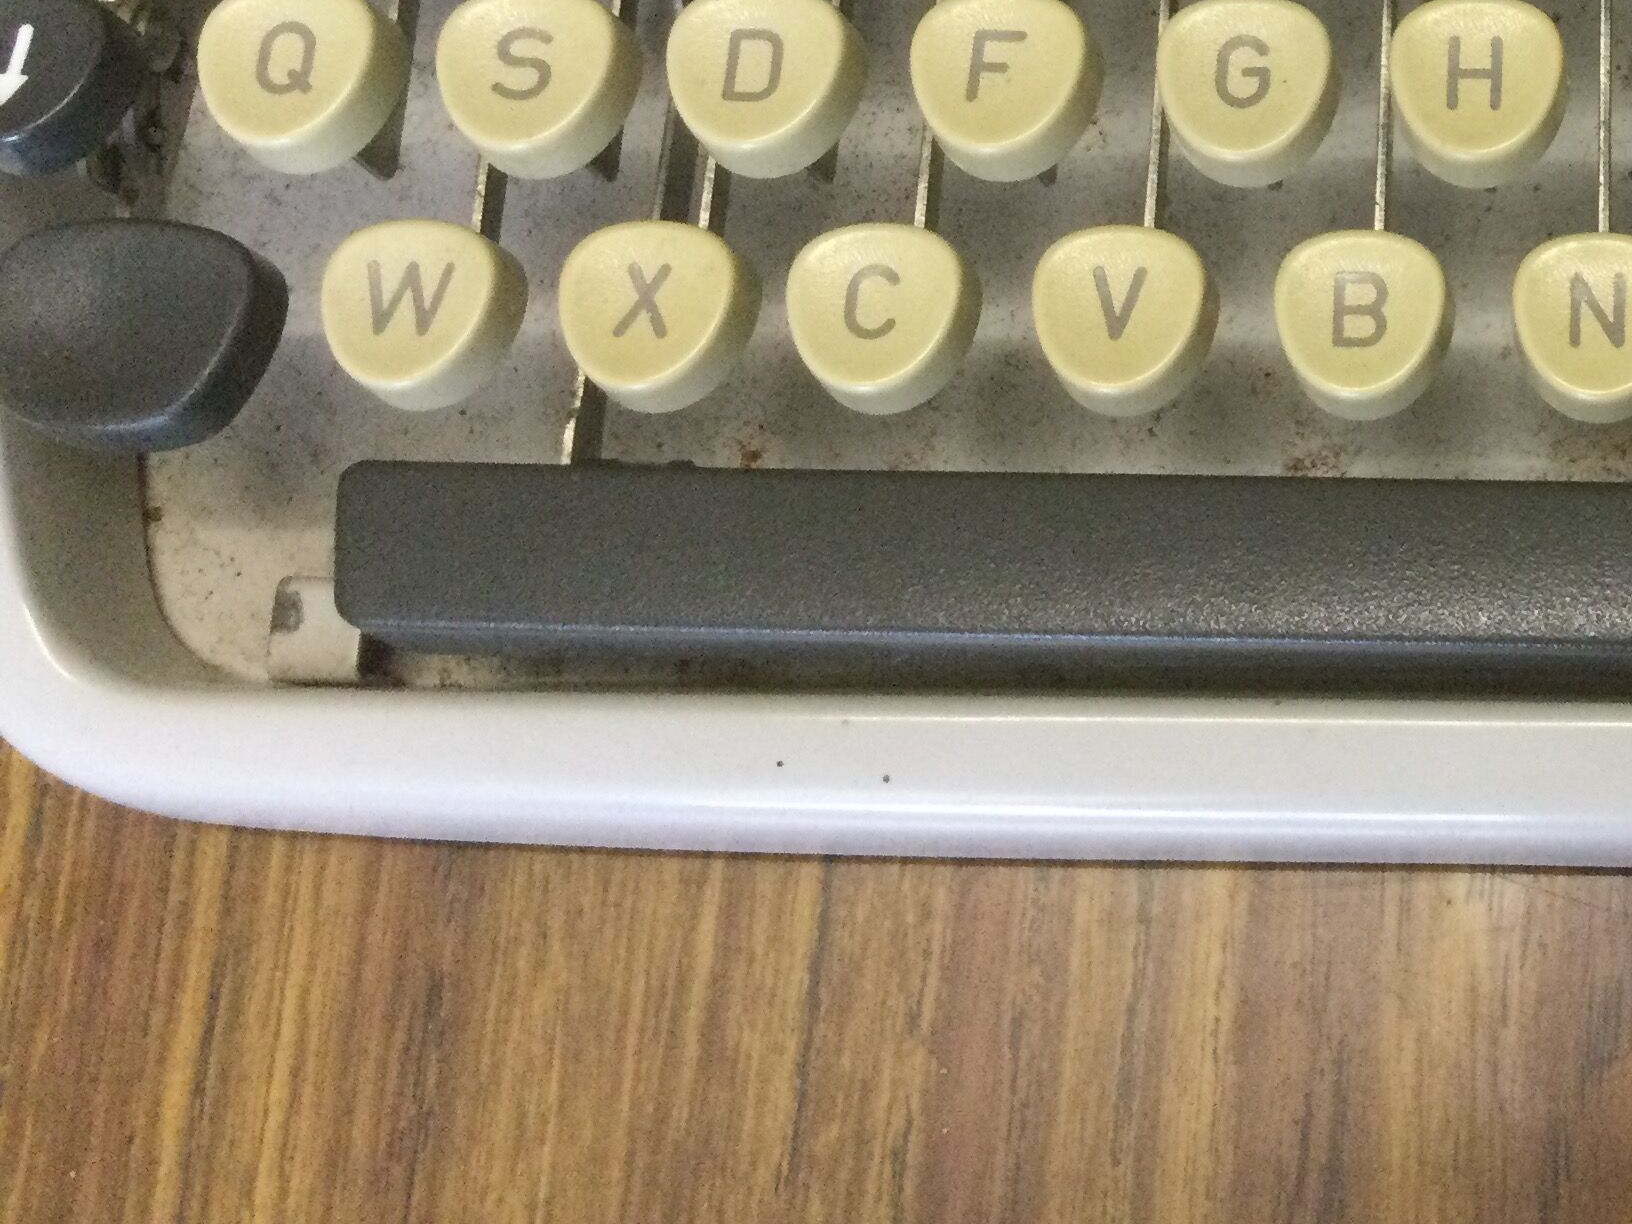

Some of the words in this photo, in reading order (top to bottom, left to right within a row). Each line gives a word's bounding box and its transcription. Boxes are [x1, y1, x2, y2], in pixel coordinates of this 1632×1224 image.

[256, 21, 316, 95] Q
[491, 28, 553, 101] S
[721, 29, 784, 102] D
[965, 29, 1027, 102] F
[1214, 35, 1271, 109] G
[1446, 36, 1503, 111] H
[368, 260, 455, 336] W
[613, 263, 672, 338] X
[844, 265, 900, 340] C
[1093, 266, 1147, 341] V
[1332, 272, 1388, 348] B
[1569, 272, 1626, 349] N
